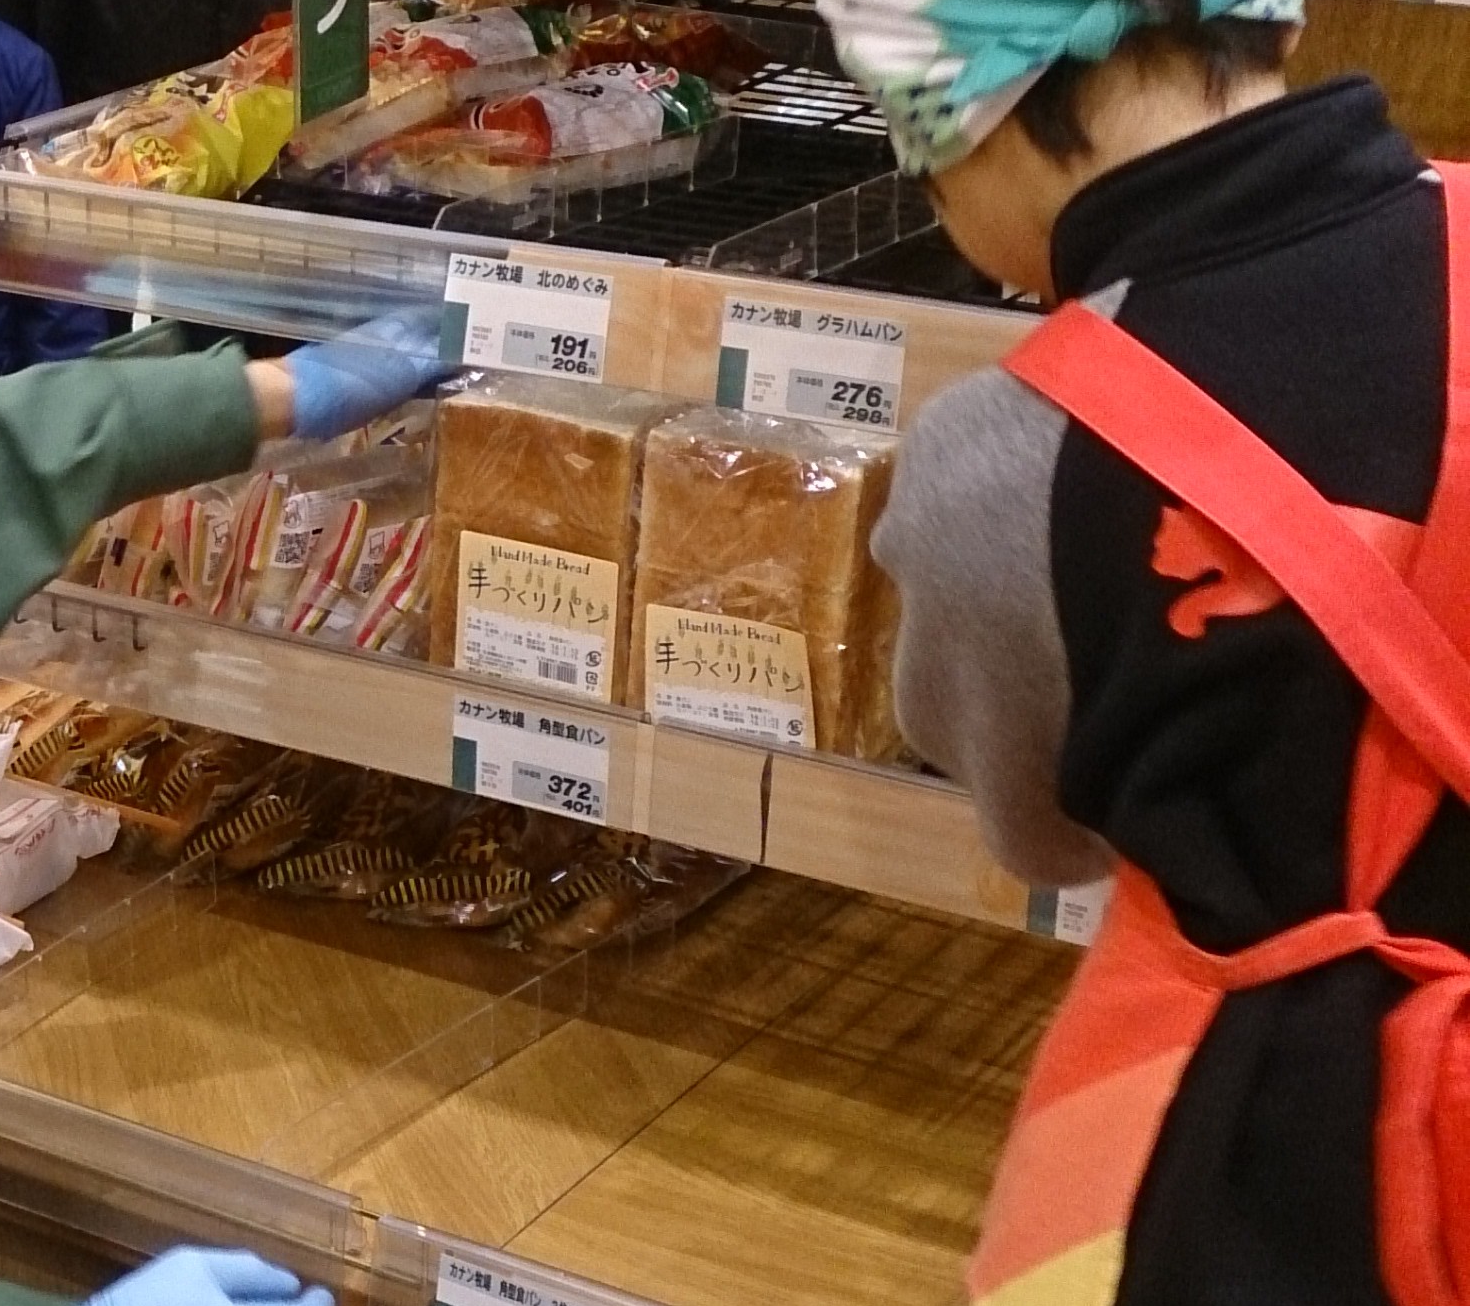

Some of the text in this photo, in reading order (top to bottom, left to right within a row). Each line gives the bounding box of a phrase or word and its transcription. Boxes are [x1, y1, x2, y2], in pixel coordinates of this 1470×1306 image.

[454, 258, 609, 296] カナン牧場 北のめぐみ
[731, 301, 903, 342] カナン牧場 グラハムパン
[556, 556, 591, 575] Bread
[468, 562, 610, 624] 手づくりパン
[747, 626, 781, 645] Bread
[655, 642, 804, 693] 手づくりパン
[459, 699, 606, 745] カナン牧場 角型食パン
[449, 1262, 493, 1293] カナン牧場
